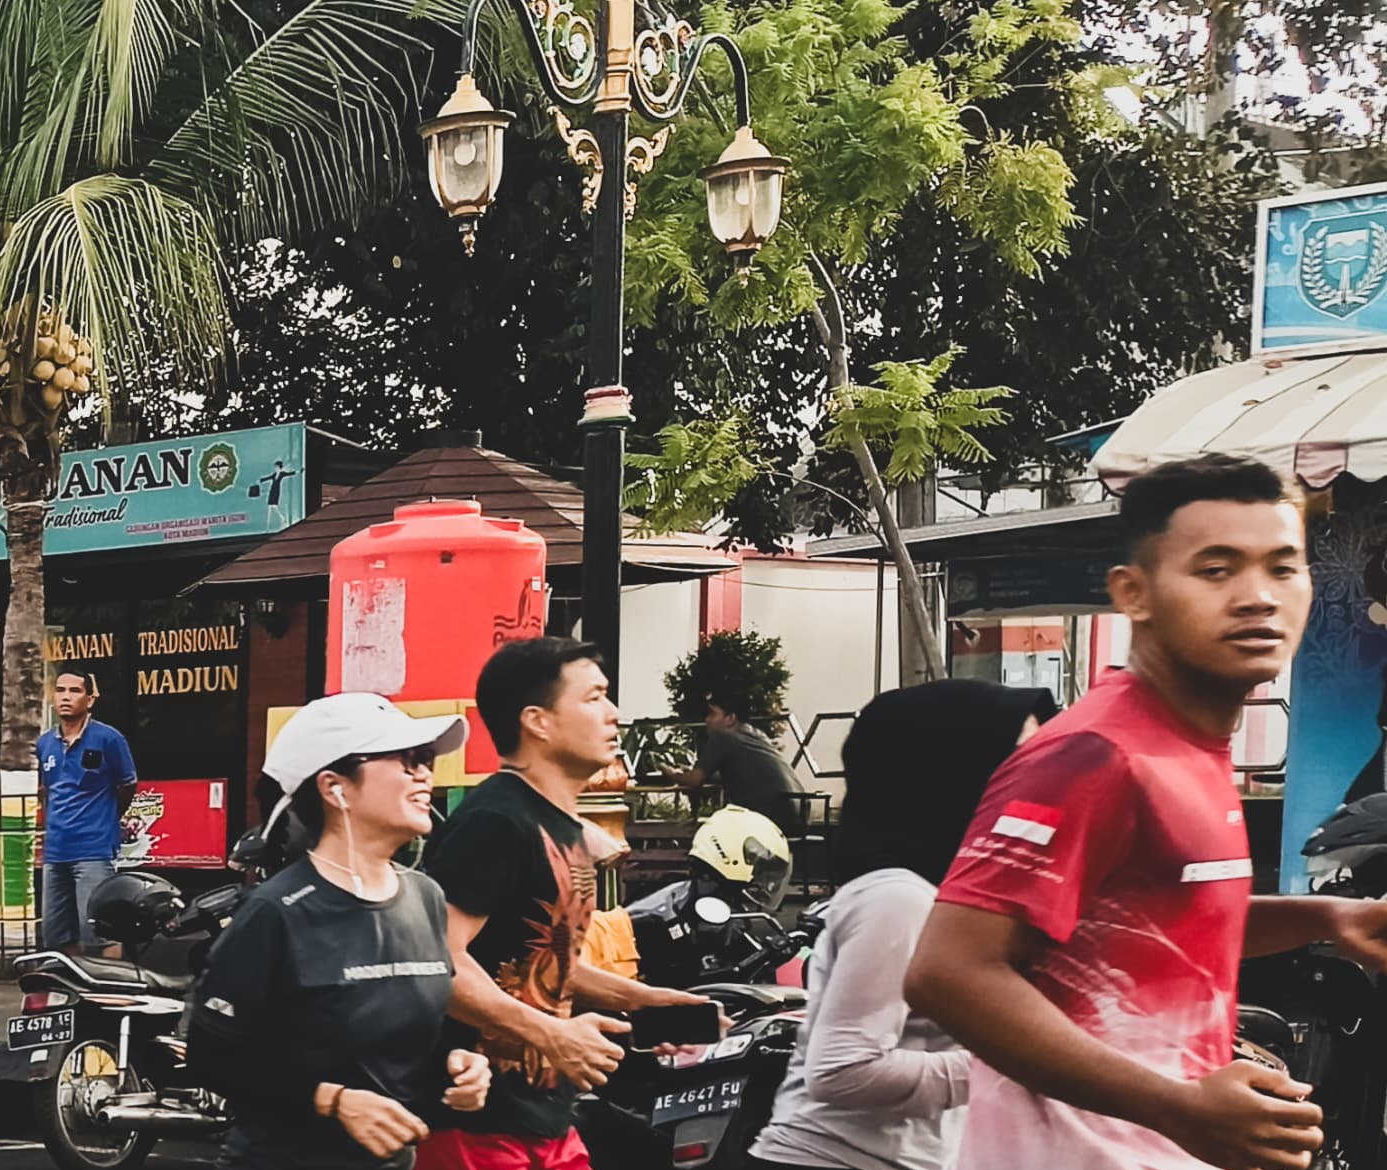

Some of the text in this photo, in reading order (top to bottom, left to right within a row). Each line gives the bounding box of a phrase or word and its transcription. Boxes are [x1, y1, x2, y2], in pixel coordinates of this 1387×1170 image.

[138, 626, 239, 656] TRADISIONAL
[137, 665, 239, 696] MADIUN
[10, 1020, 25, 1034] AE
[655, 1081, 740, 1111] AE 4647 FU
